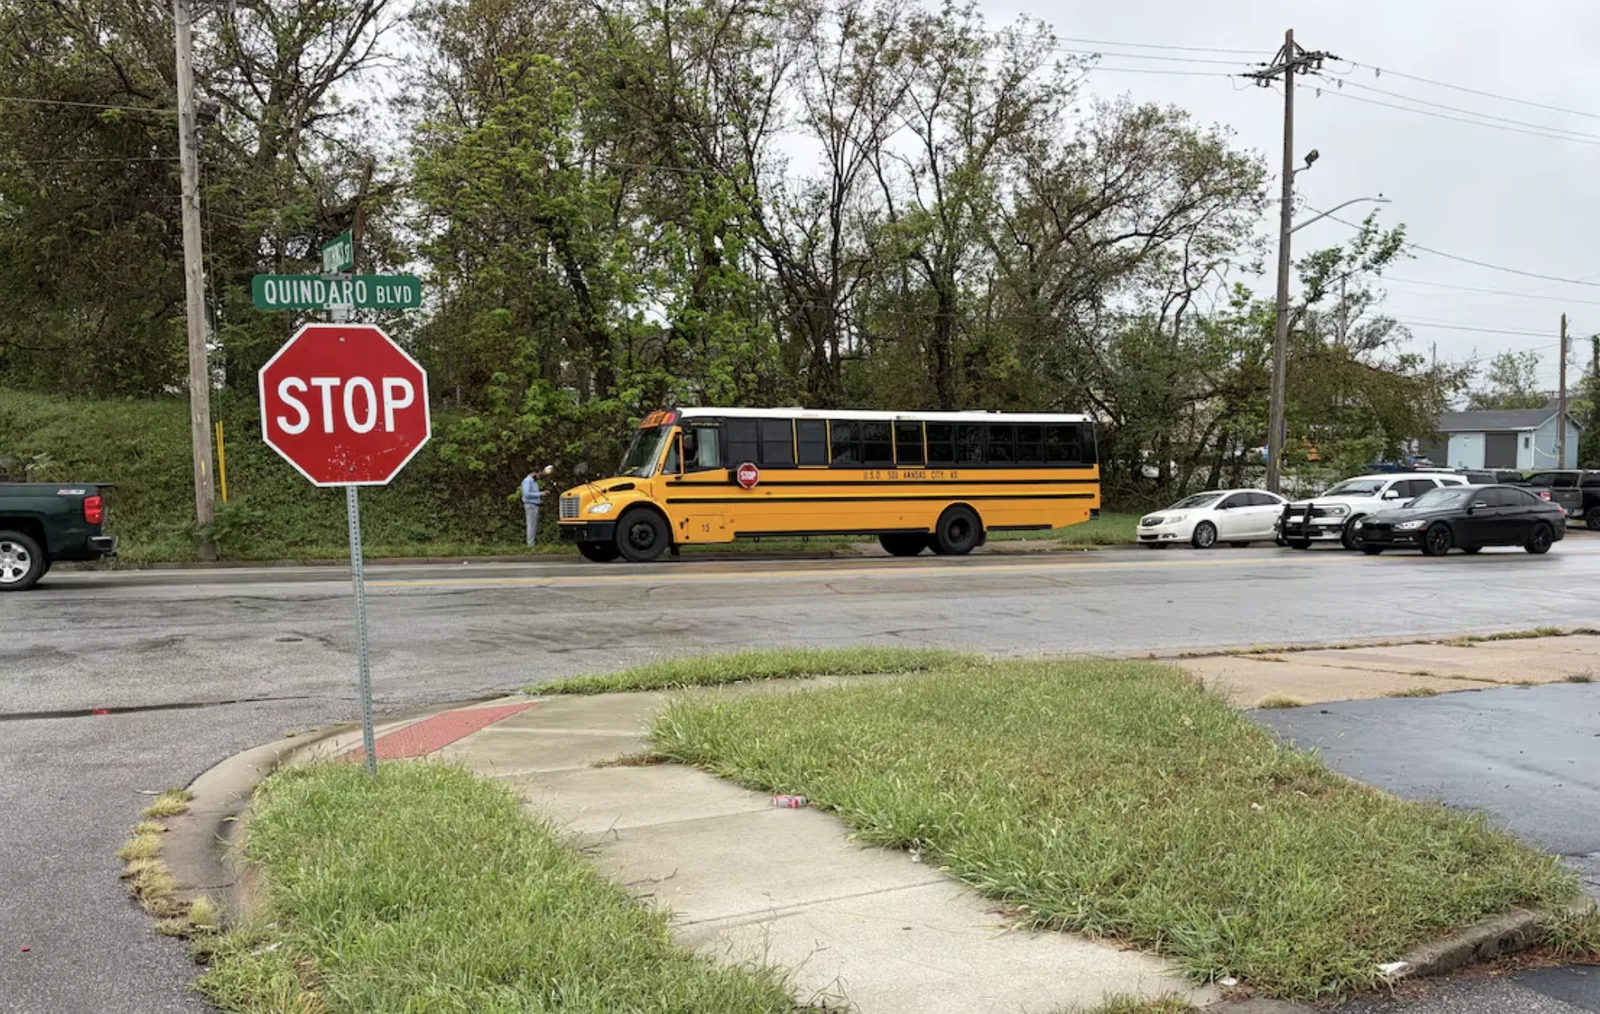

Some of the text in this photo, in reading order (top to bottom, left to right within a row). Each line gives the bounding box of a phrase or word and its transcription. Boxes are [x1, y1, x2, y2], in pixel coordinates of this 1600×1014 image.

[264, 279, 412, 304] QUINDARO BLVD
[277, 376, 415, 435] STOP
[740, 470, 757, 480] STOP
[903, 470, 926, 479] KANSAS
